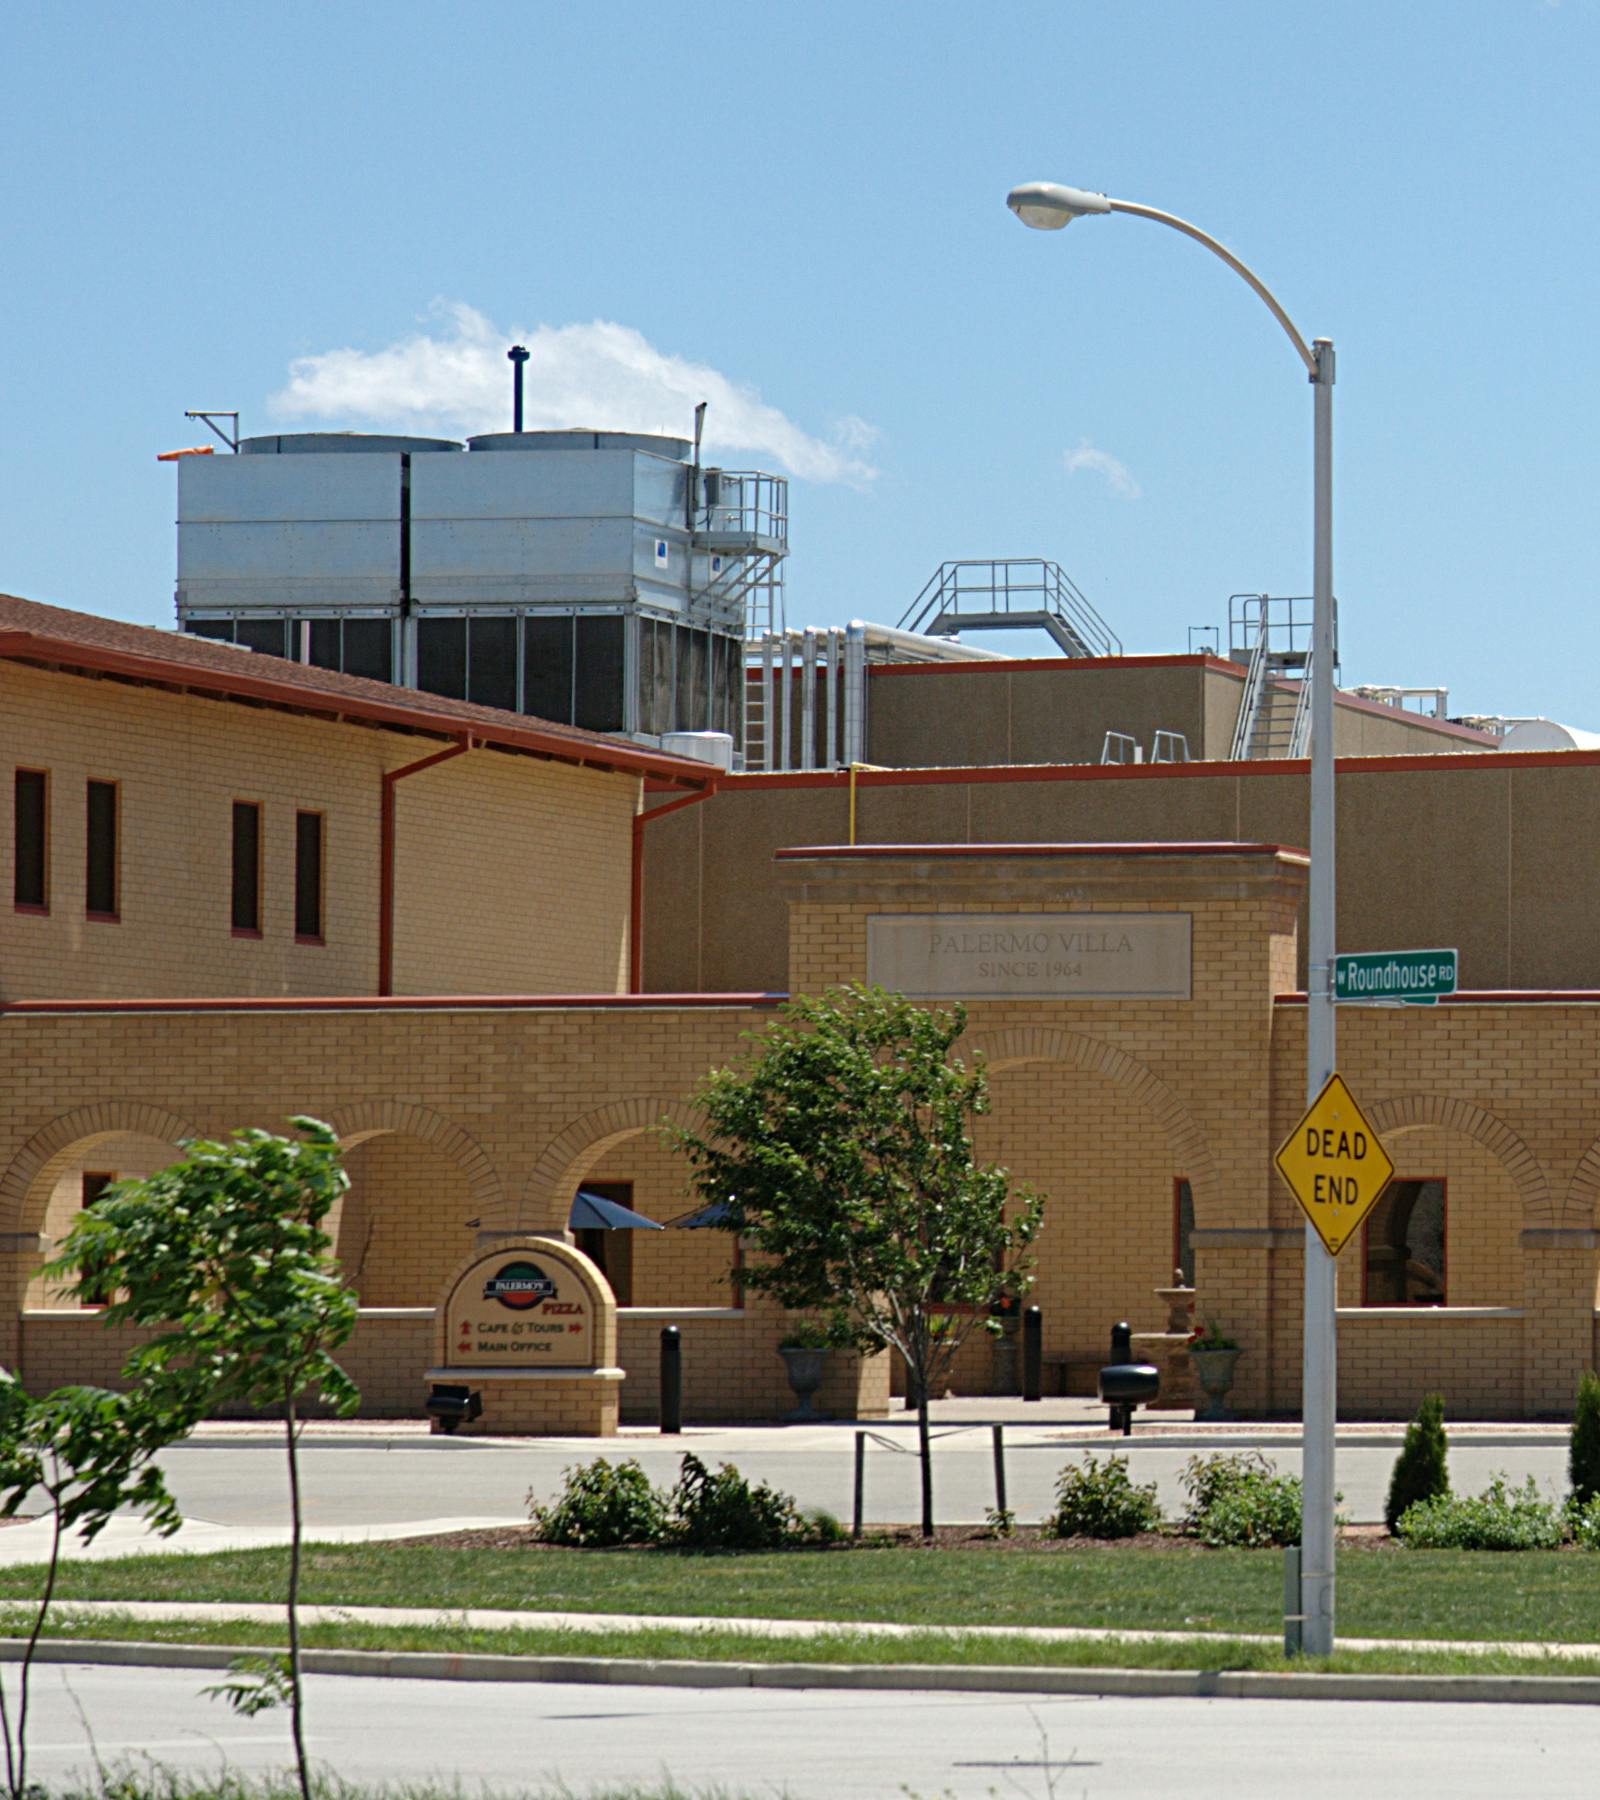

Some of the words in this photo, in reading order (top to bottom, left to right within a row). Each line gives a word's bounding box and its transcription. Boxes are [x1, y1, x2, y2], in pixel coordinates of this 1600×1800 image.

[929, 933, 1050, 953] PALERMO
[1058, 932, 1133, 953] VILLA
[978, 961, 1039, 978] SINCE
[1045, 961, 1083, 978] 1964
[1337, 970, 1346, 985] W
[1347, 960, 1437, 991] Roundhouse
[1439, 965, 1454, 981] RD
[1306, 1127, 1367, 1160] DEAD
[1313, 1174, 1359, 1205] END
[542, 1302, 584, 1315] PIZZA
[477, 1322, 509, 1334] CAFE
[511, 1321, 524, 1336] &
[527, 1322, 565, 1334] TOURS
[477, 1341, 508, 1352] MAIN
[510, 1341, 553, 1353] OFFICE
